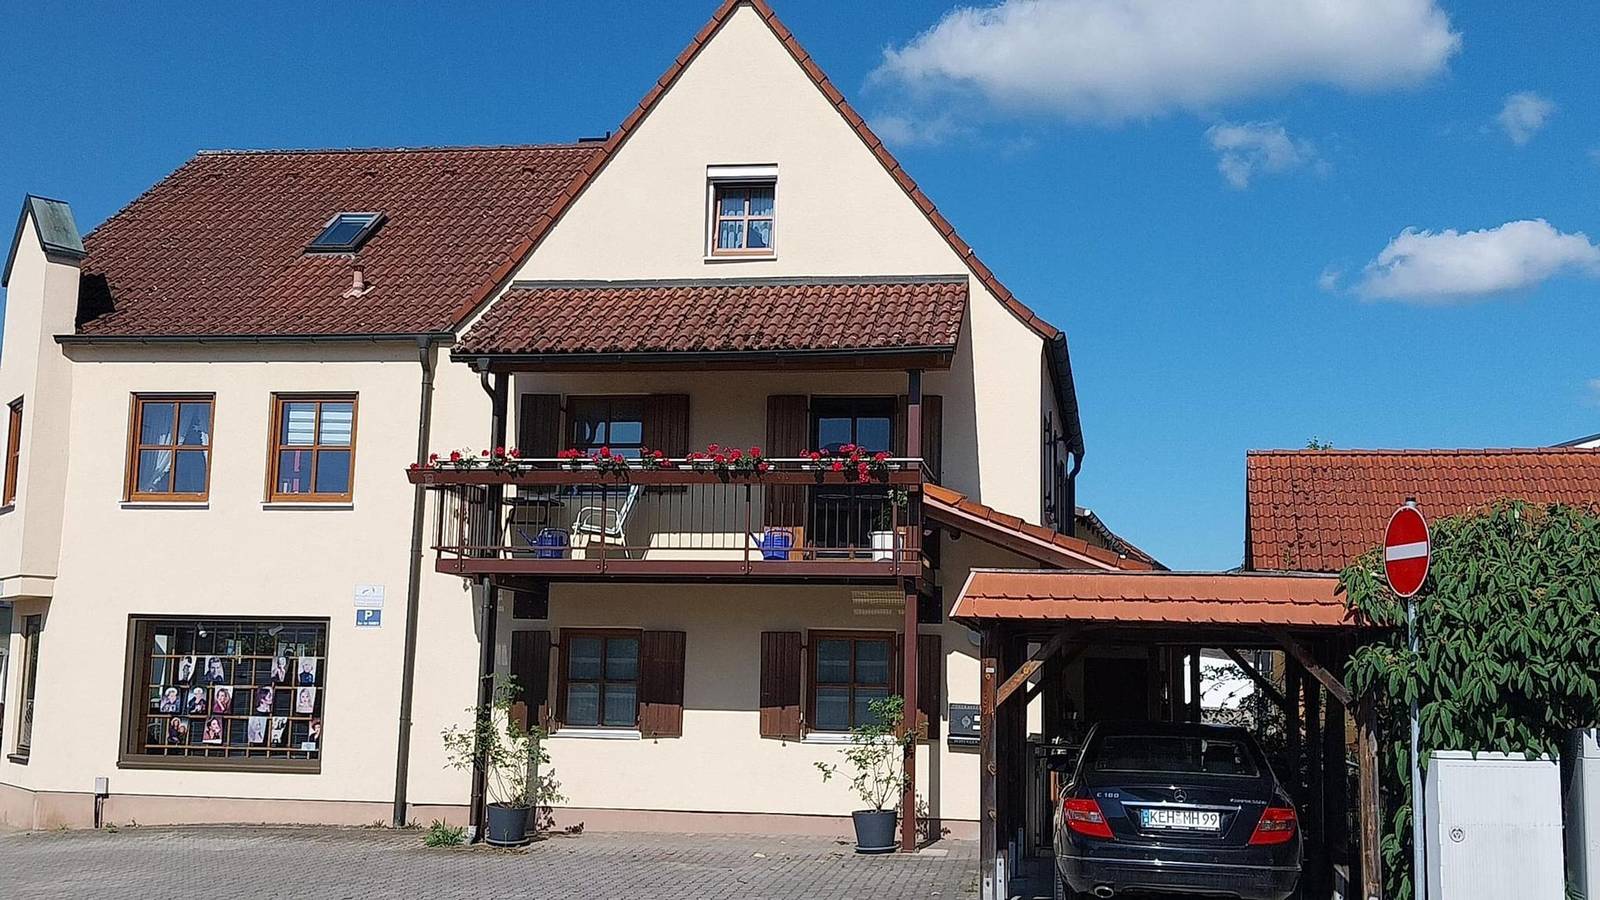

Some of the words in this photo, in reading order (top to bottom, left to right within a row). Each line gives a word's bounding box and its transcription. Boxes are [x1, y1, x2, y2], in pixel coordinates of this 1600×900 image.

[364, 610, 373, 621] P
[1150, 810, 1175, 823] KEH
[1183, 811, 1200, 825] MH
[1202, 813, 1218, 826] 99
